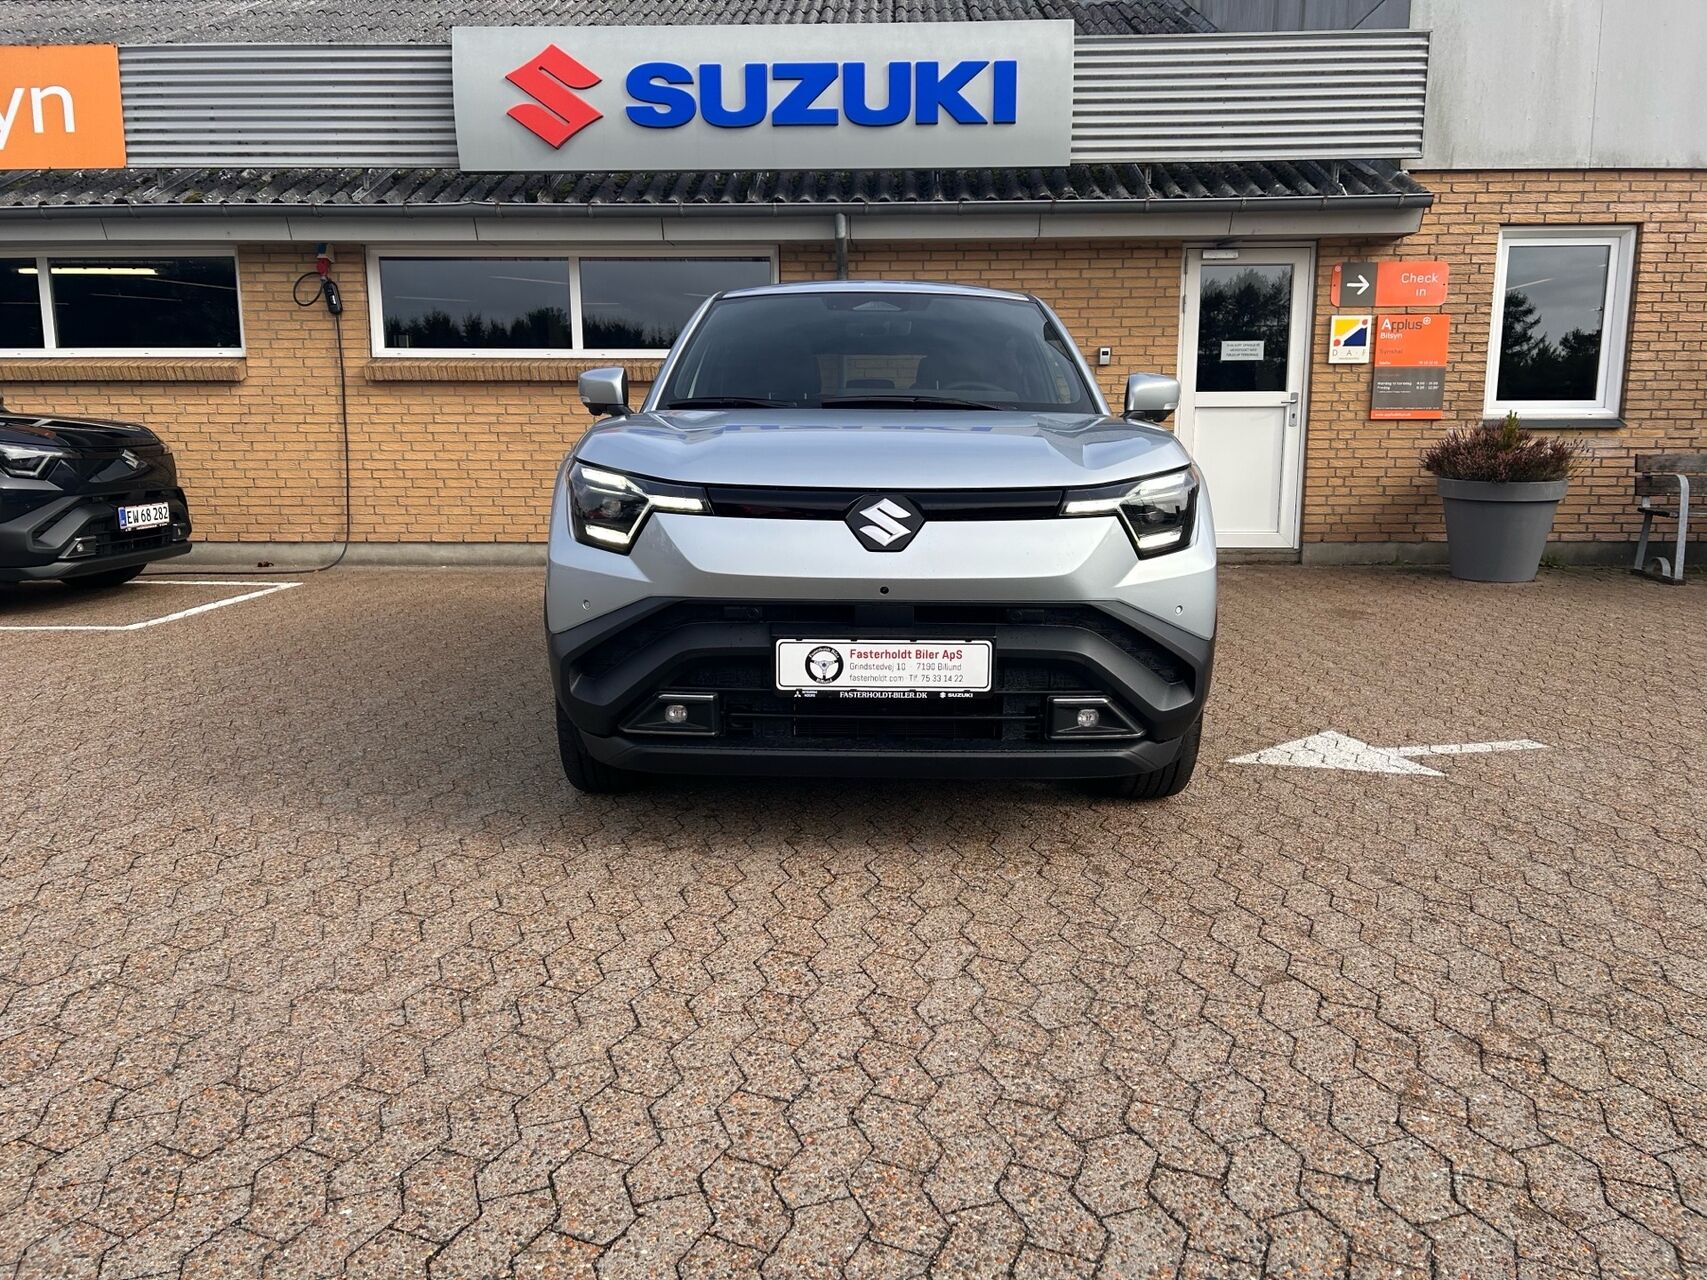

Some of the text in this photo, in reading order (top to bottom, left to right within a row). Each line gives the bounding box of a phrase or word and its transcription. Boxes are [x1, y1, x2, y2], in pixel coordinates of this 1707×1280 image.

[625, 60, 1017, 128] SUZUKI
[1401, 273, 1439, 283] Check
[1416, 288, 1427, 296] in
[1380, 332, 1402, 340] Bilsyn
[126, 506, 169, 525] EW 68 282
[850, 649, 963, 661] Fasterholdt Biler ApS
[849, 663, 962, 672] Grindstedvej 10 7190 Billund
[921, 674, 930, 682] 75
[932, 674, 942, 682] 33
[944, 674, 952, 682] 14
[954, 674, 964, 682] 22
[840, 691, 928, 699] FASTERHOLDT-BILER.DK
